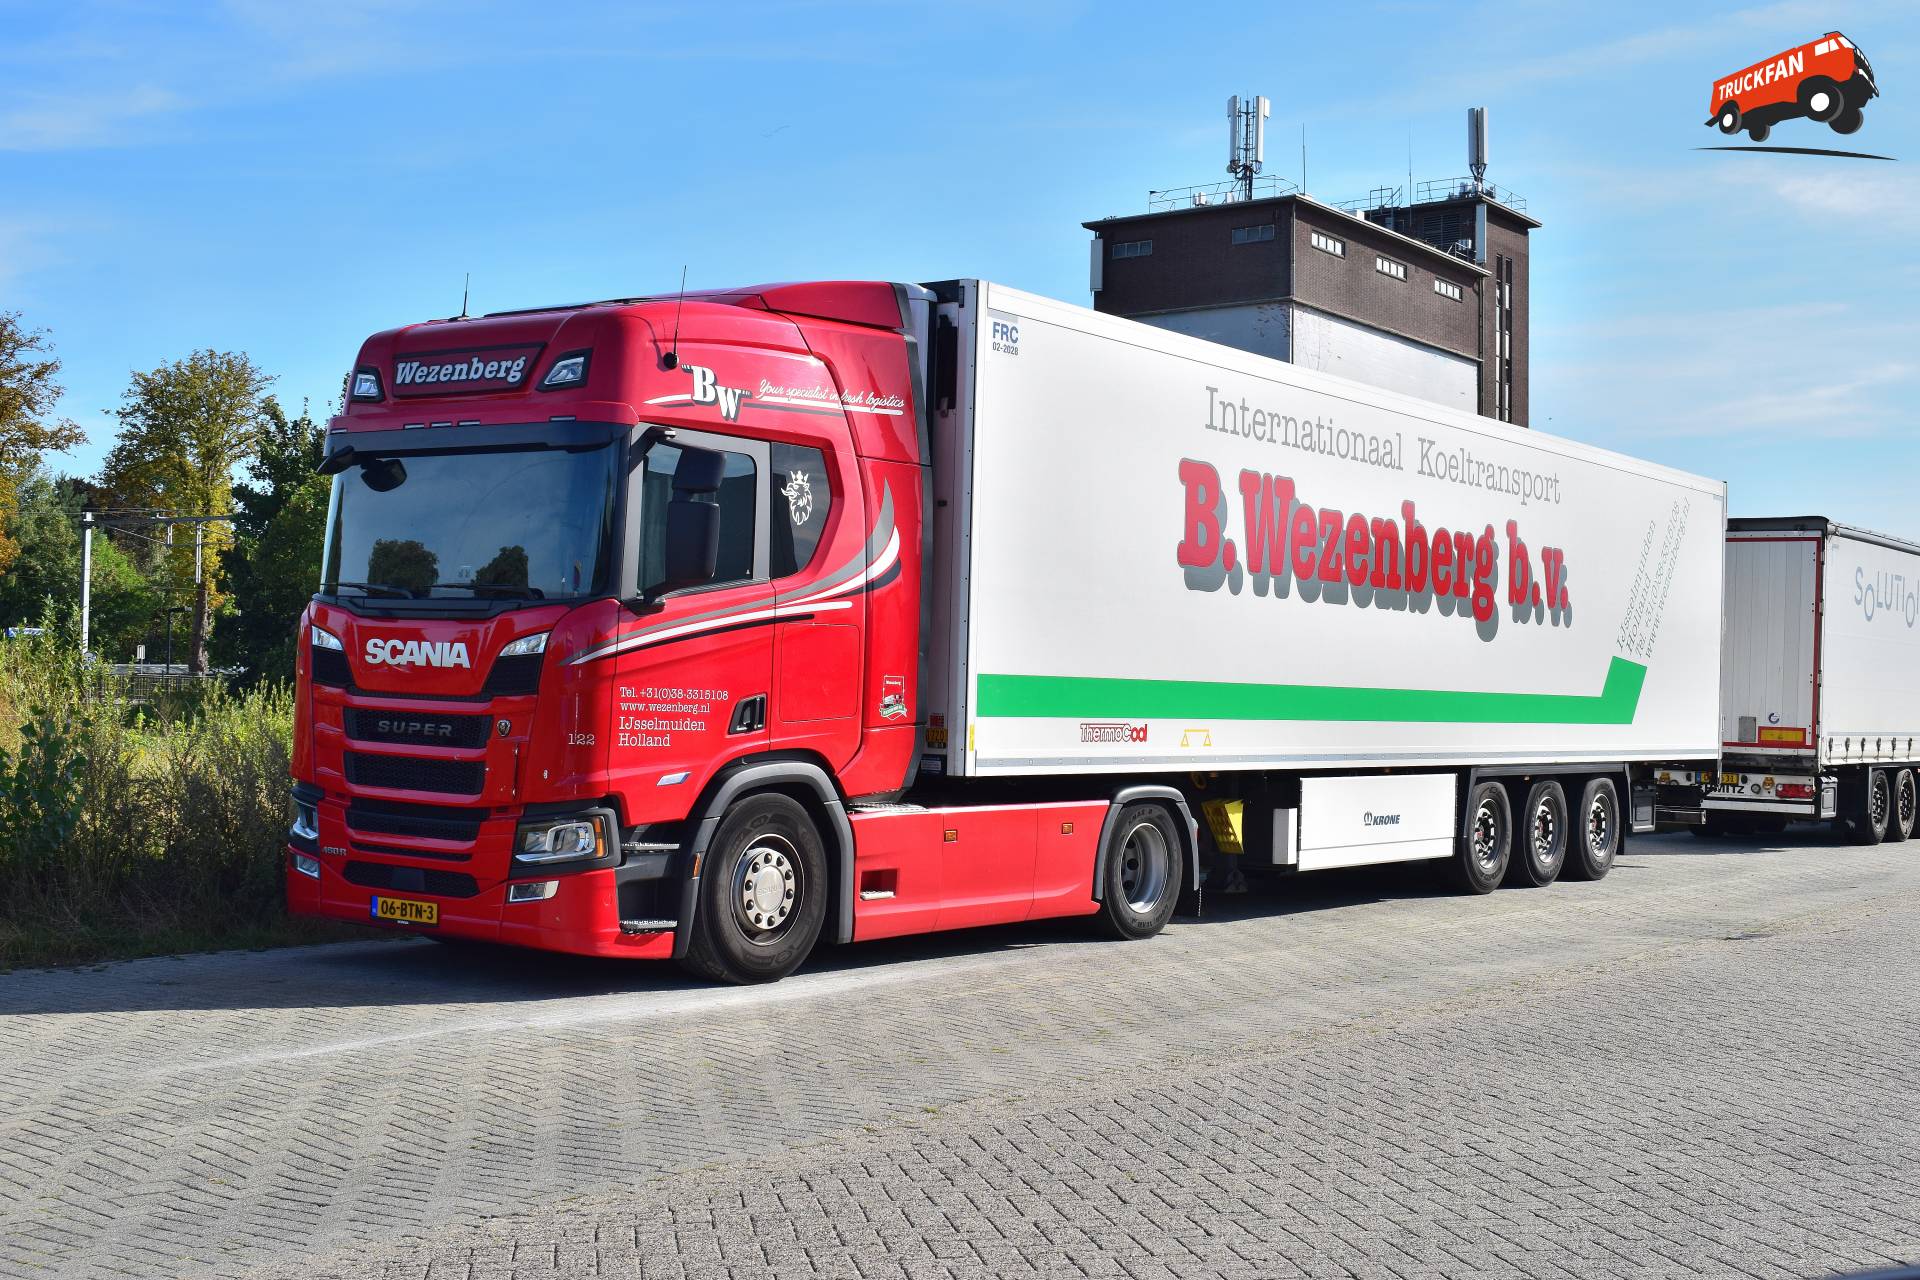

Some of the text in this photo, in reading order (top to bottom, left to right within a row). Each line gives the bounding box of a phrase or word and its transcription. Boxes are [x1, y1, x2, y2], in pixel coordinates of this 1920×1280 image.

[992, 321, 1019, 344] FRC
[992, 341, 1019, 355] 02-2028
[395, 355, 526, 385] Wezenberg
[756, 379, 784, 399] Your
[786, 385, 829, 401] specialist
[865, 392, 904, 411] logistics
[1205, 386, 1561, 505] Internationaal Koeltransport
[1506, 519, 1571, 620] b.v.
[1854, 566, 1920, 629] SOLUTIO
[1626, 573, 1651, 655] Holland
[365, 638, 471, 669] SCANIA
[619, 687, 638, 698] Tel.
[620, 702, 710, 715] www.wezenberg.nl
[378, 719, 453, 738] SUPER
[619, 716, 706, 731] IJsselmuiden
[1080, 723, 1148, 743] ThermoCool
[568, 733, 595, 746] 122
[618, 732, 671, 747] Holland
[1372, 814, 1401, 826] KRONE
[381, 900, 435, 920] 06-BTN-3
